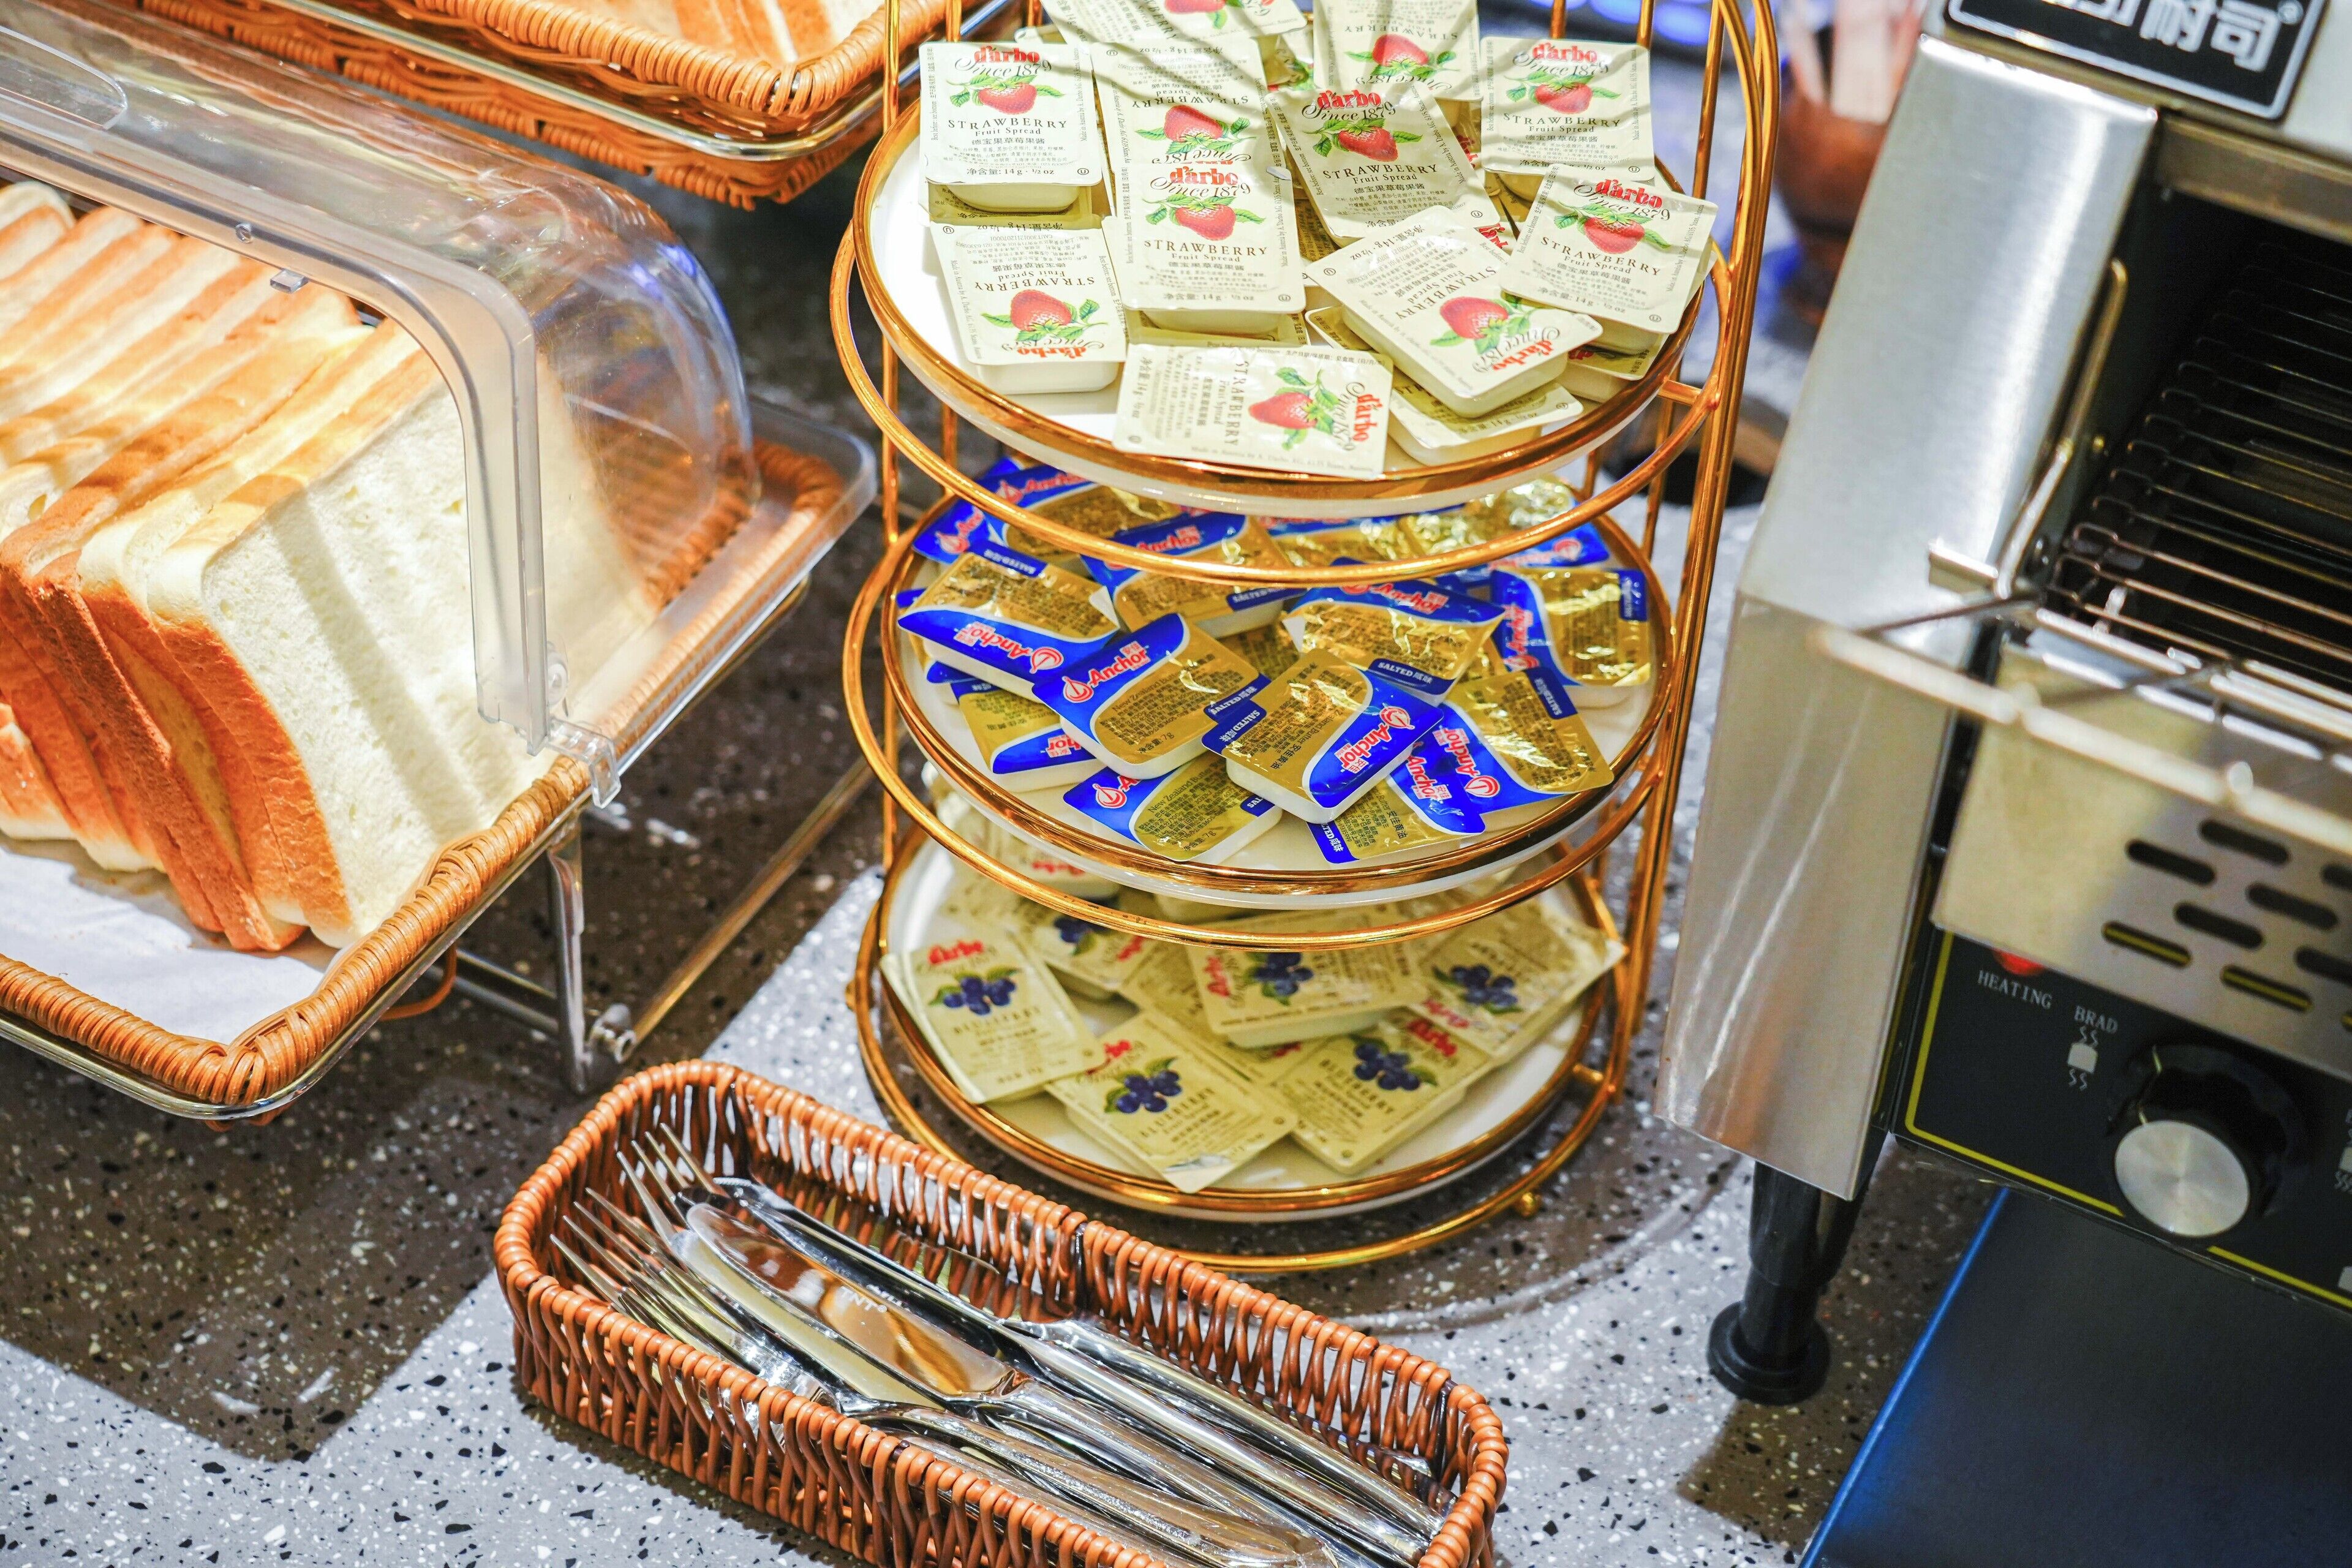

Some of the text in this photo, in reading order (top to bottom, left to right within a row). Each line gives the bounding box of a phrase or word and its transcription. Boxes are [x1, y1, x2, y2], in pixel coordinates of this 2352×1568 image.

[1344, 25, 1458, 40] STRAWBERRY
[974, 45, 1040, 64] d'arbo
[1513, 51, 1609, 77] Since 1879
[954, 58, 1052, 77] Since 1879
[1132, 95, 1249, 108] STRAWBERRY
[1316, 89, 1382, 111] d'arbo
[1302, 101, 1396, 121] Since 1879
[1503, 113, 1621, 127] STRAWBERRY
[948, 118, 1067, 130] STRAWBERRY
[975, 127, 1041, 137] Fruit Spread
[1559, 125, 1594, 134] Spread
[1433, 129, 1444, 143] Darbo
[1322, 163, 1438, 179] STRAWBERRY
[1446, 153, 1457, 169] Austria
[1170, 165, 1238, 185] d'arbo
[1352, 173, 1418, 184] Fruit Spread
[1455, 171, 1466, 184] Made
[1150, 176, 1251, 197] Since 1879
[1354, 183, 1425, 194] 德宝果草莓果酱
[1595, 179, 1664, 209] d'arbo
[1574, 184, 1671, 221] Since 1879
[1144, 239, 1268, 256] STRAWBERRY
[1350, 252, 1362, 261] oz
[1384, 236, 1395, 247] 14
[1540, 236, 1661, 276] STRAWBERRY
[1204, 254, 1241, 263] Spread
[1564, 255, 1632, 274] Fruit Spread
[974, 276, 1095, 292] STRAWBERRY
[998, 271, 1033, 281] Spread
[1395, 266, 1498, 321] STRAWBERRY
[1407, 270, 1466, 304] Spread Fruit
[1493, 337, 1555, 371] d'arbo
[1224, 360, 1250, 447] STRAWBERRY
[1333, 381, 1365, 421] Since
[1354, 393, 1382, 442] d'arbo
[961, 626, 1031, 659] Anchor
[1089, 649, 1148, 688] Anchor
[1378, 661, 1413, 677] SALTED
[1112, 700, 1130, 714] New
[1210, 696, 1241, 715] SALTED
[1234, 709, 1261, 733] SALTED
[1270, 727, 1317, 770] Butter 安佳黄油
[1338, 724, 1393, 770] Anchor
[1444, 728, 1480, 776] Anchor
[1348, 759, 1369, 774] 安佳
[1408, 755, 1438, 799] Anchor
[1147, 797, 1163, 813] New
[1161, 781, 1191, 802] Zealand
[1204, 829, 1217, 840] 7g
[1387, 811, 1408, 839] 安佳黄油
[1329, 838, 1344, 853] 咸味
[1977, 969, 2053, 1009] HEATING
[2074, 1005, 2119, 1035] BRAD
